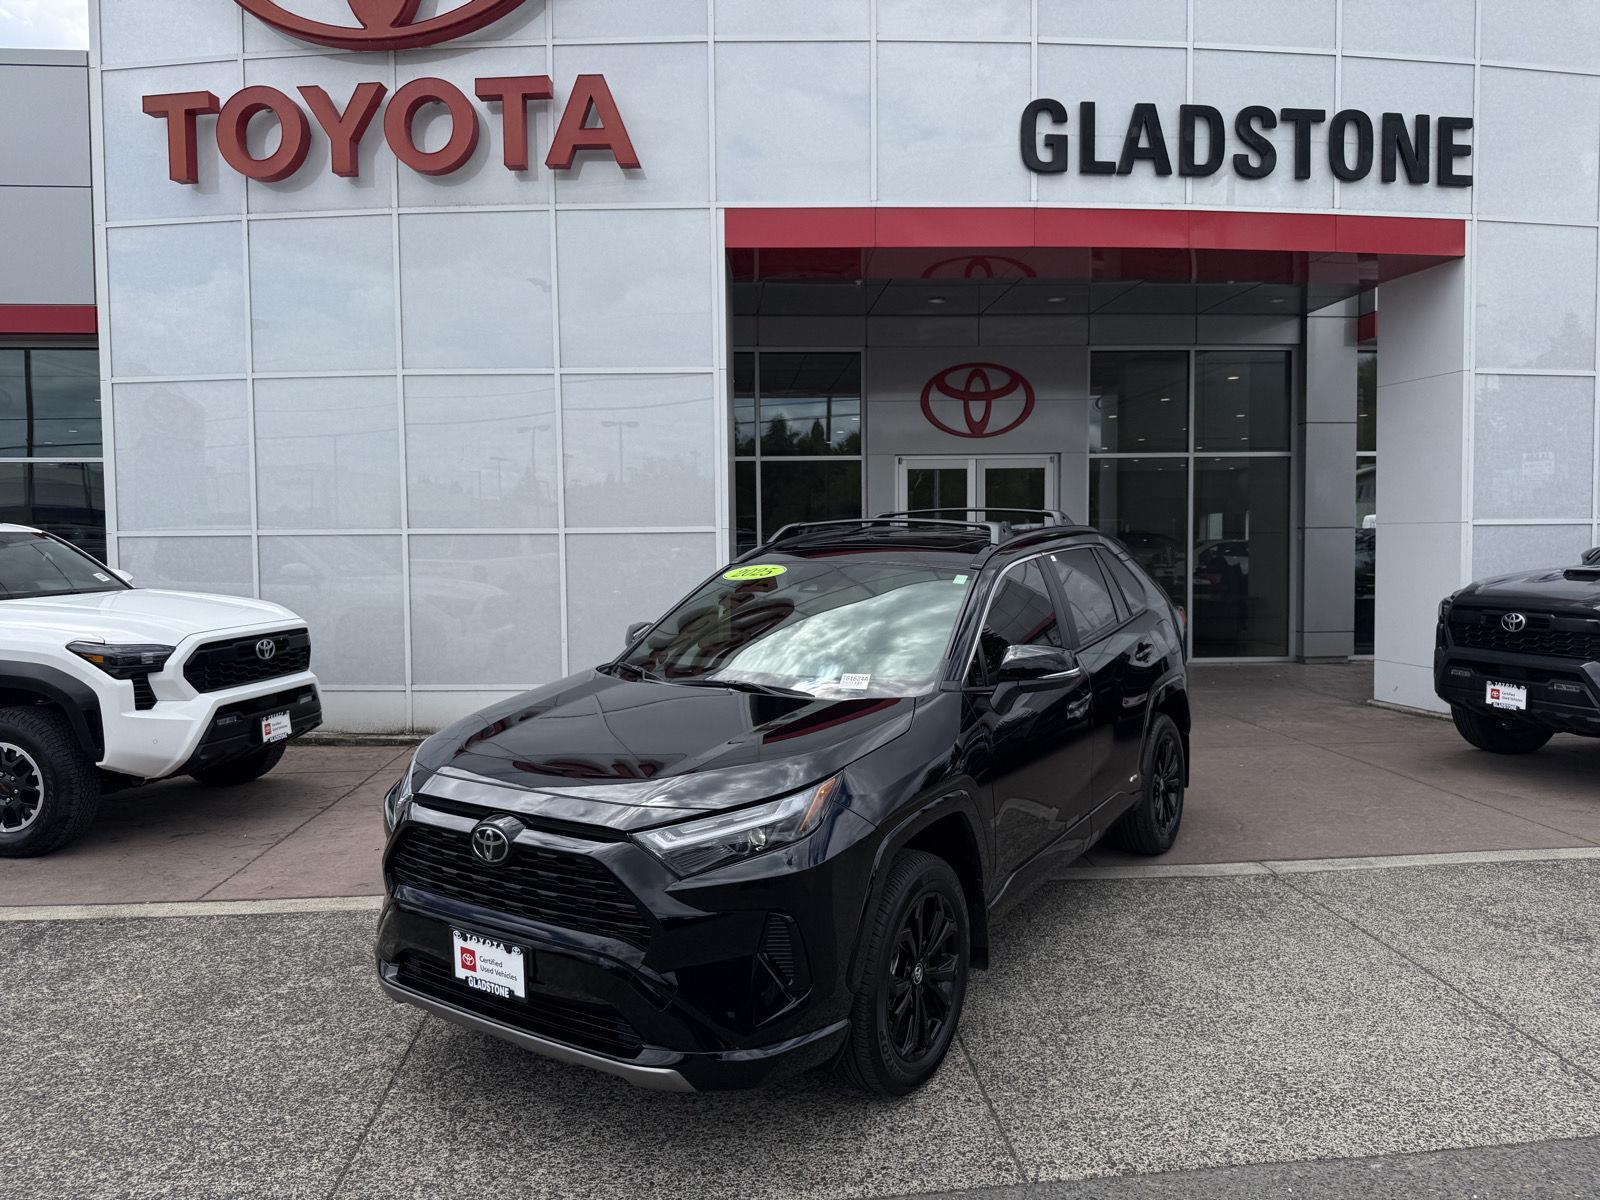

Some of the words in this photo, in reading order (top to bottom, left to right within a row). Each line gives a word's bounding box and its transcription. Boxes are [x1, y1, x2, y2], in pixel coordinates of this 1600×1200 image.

[142, 74, 641, 184] TOYOTA
[1020, 98, 1473, 186] GLADSTONE
[465, 933, 506, 951] TOYOTA
[479, 955, 503, 968] Certified
[480, 965, 494, 975] Used
[494, 967, 518, 982] Vehicles
[468, 976, 510, 999] GLADSTONE
